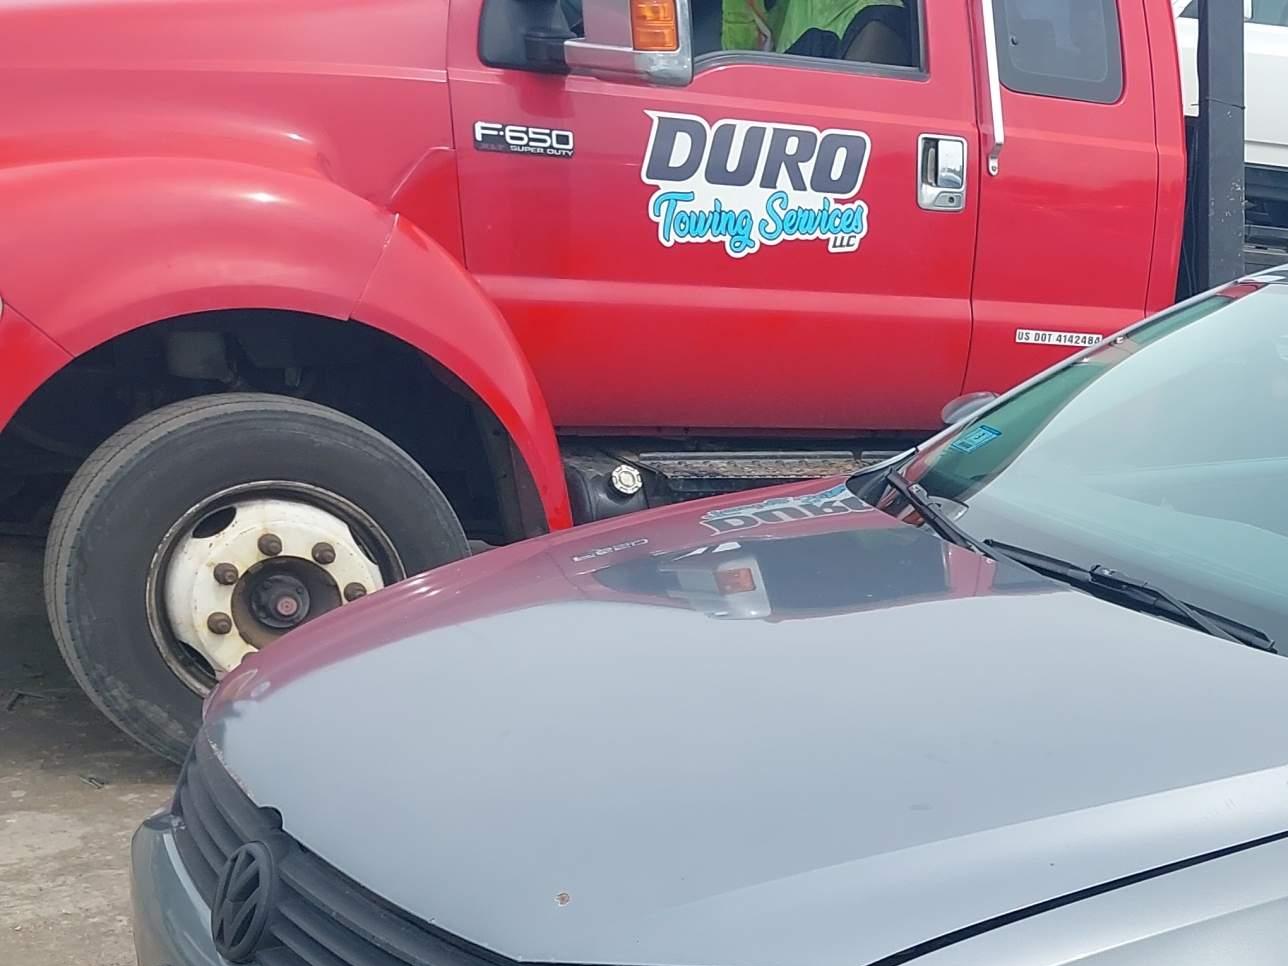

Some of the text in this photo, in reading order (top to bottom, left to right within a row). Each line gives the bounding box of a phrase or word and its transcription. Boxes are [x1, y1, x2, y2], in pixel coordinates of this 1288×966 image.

[510, 145, 544, 154] SUPER
[547, 148, 573, 156] DUTY
[646, 116, 867, 194] DURO
[653, 191, 864, 252] Towing Services
[832, 235, 856, 248] LLC
[1018, 332, 1030, 341] US
[1034, 333, 1052, 343] DOT
